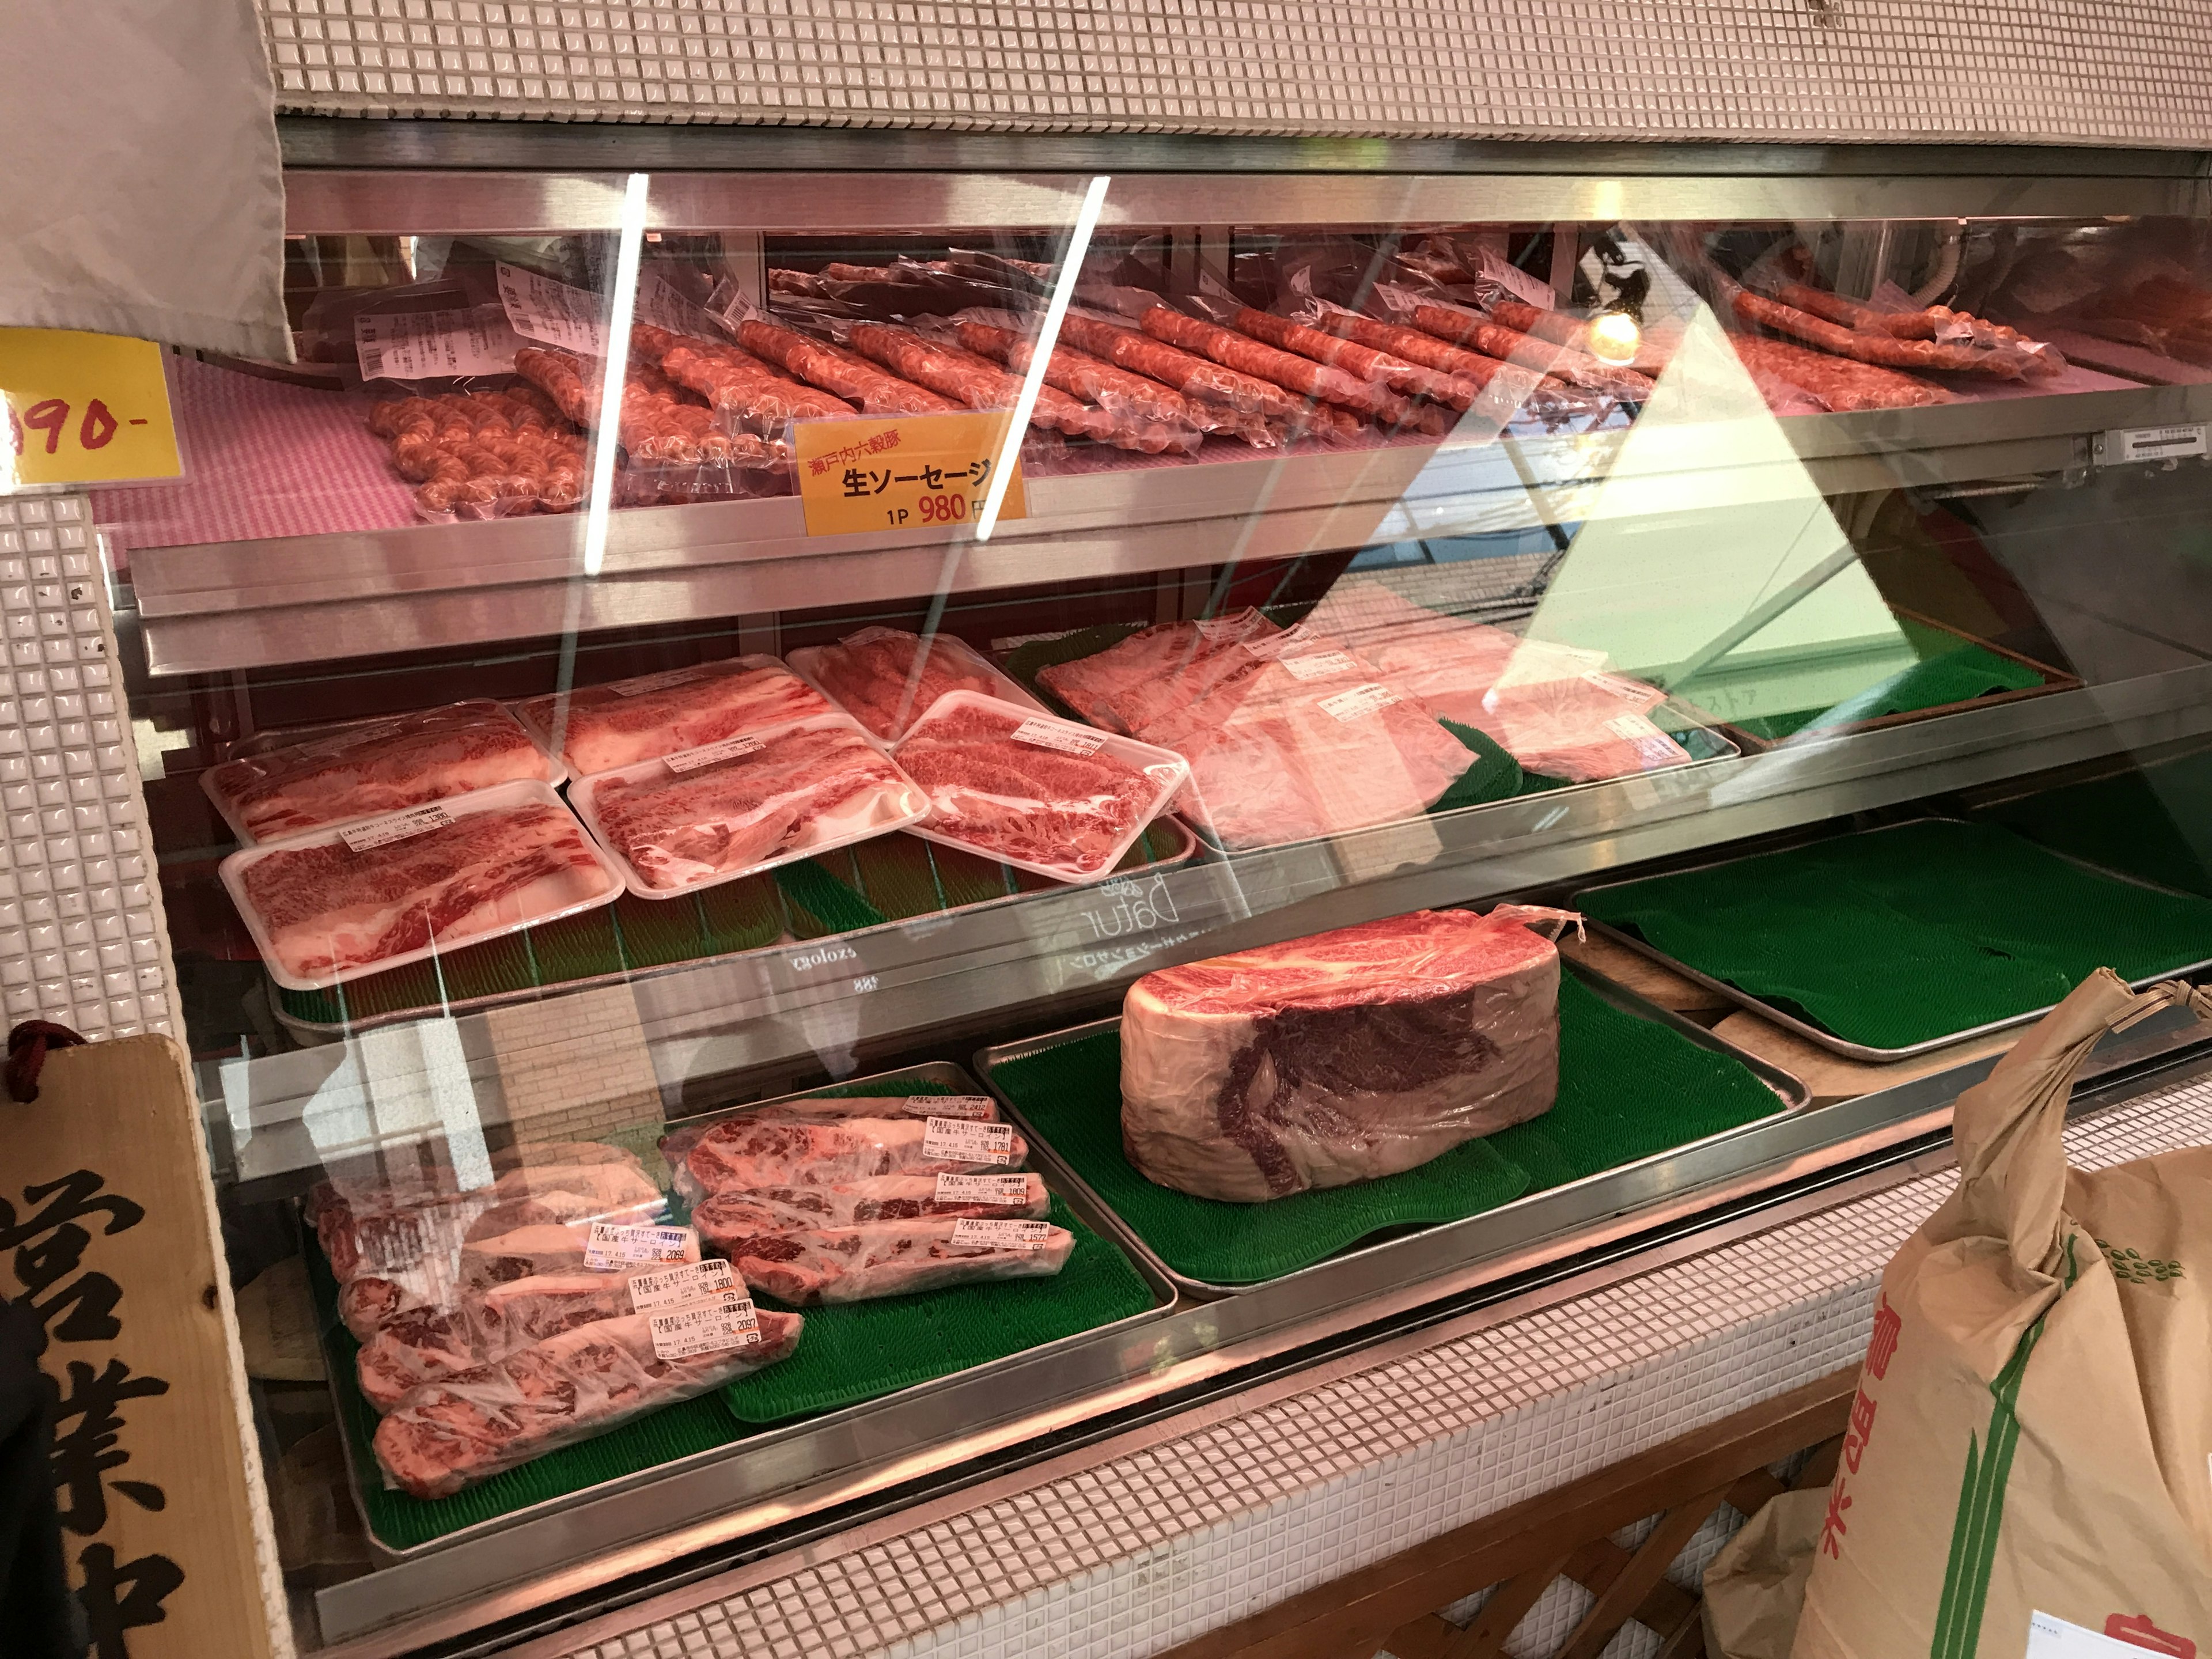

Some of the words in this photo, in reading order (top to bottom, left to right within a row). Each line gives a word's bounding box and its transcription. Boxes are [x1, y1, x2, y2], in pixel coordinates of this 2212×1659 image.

[808, 429, 902, 476] 瀬戸内六穀豚
[842, 459, 993, 498] 生ソーセージ
[887, 509, 909, 525] 1P
[918, 493, 967, 523] 980
[429, 812, 448, 822] 1380
[994, 1141, 1009, 1152] 1781
[666, 1249, 685, 1260] 2069
[714, 1277, 733, 1291] 1800
[737, 1318, 756, 1331] 2097
